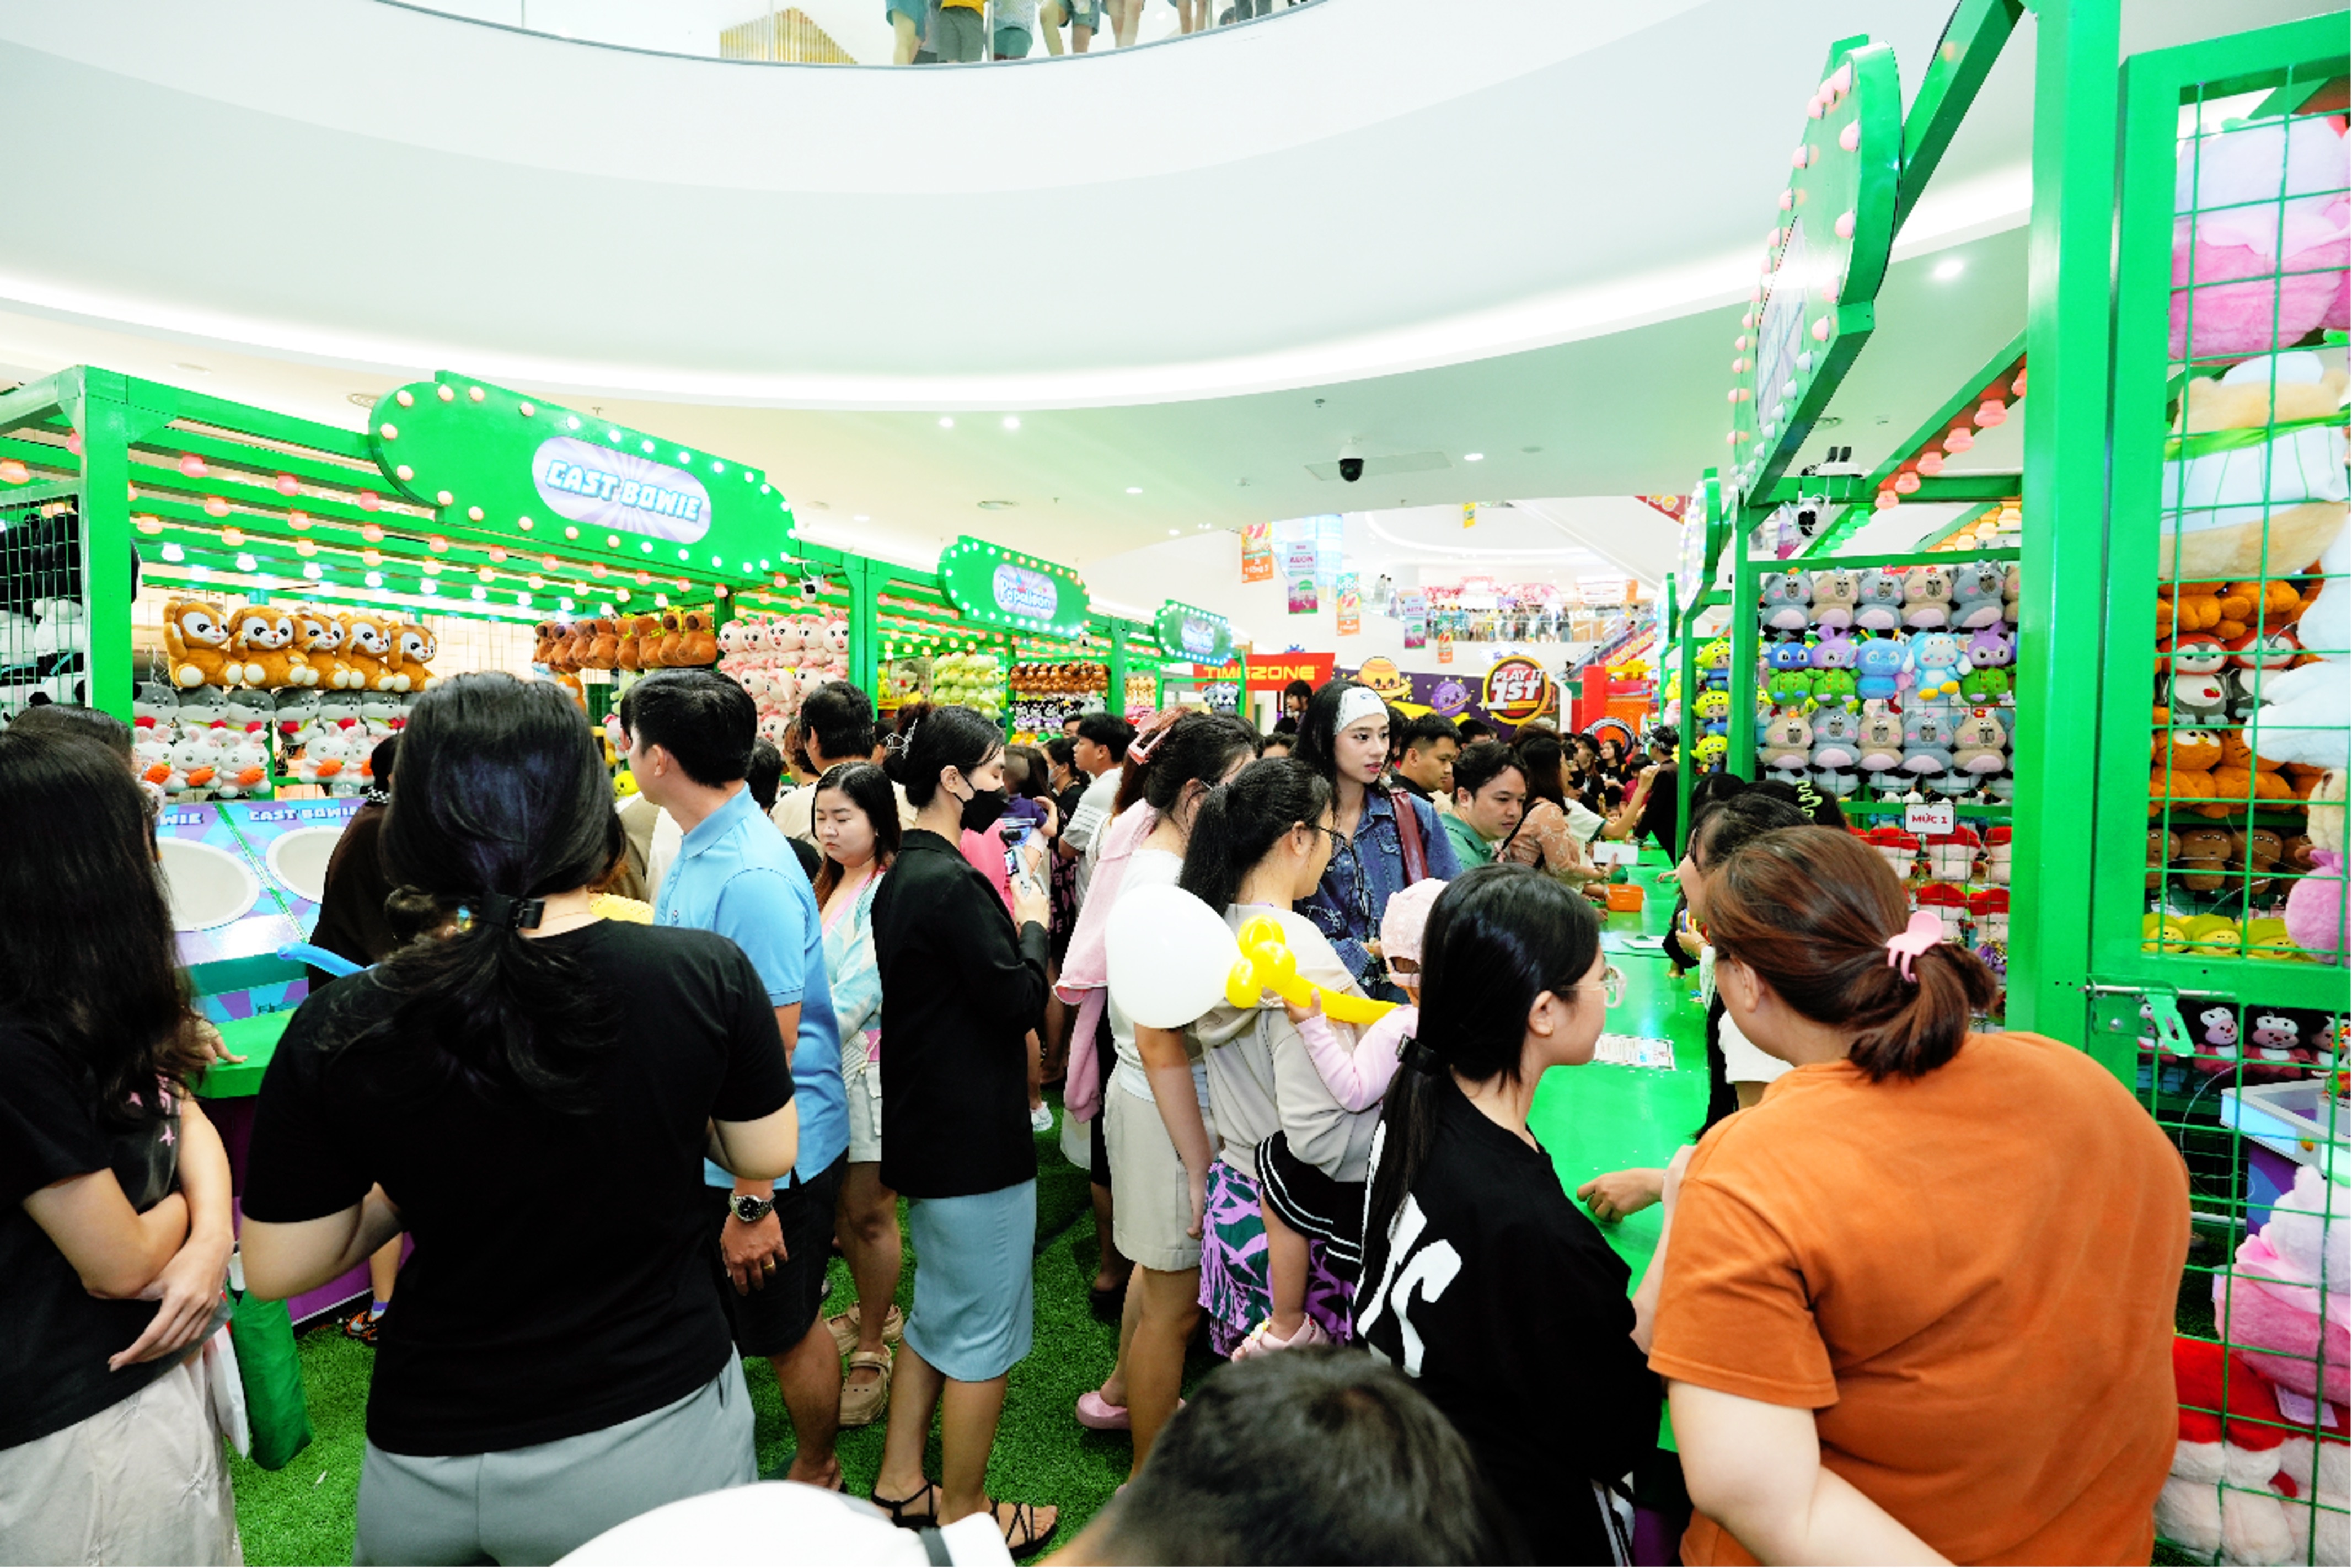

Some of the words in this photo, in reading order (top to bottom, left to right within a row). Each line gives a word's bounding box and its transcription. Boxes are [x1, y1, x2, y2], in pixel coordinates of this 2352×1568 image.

[545, 460, 621, 501] CAST
[619, 479, 703, 522] BOWIE
[1492, 669, 1530, 683] PLAY
[1530, 668, 1544, 681] IT
[1486, 680, 1542, 710] 1ST
[159, 813, 203, 826] WIE
[249, 809, 298, 822] CAST
[1941, 815, 1948, 824] 1
